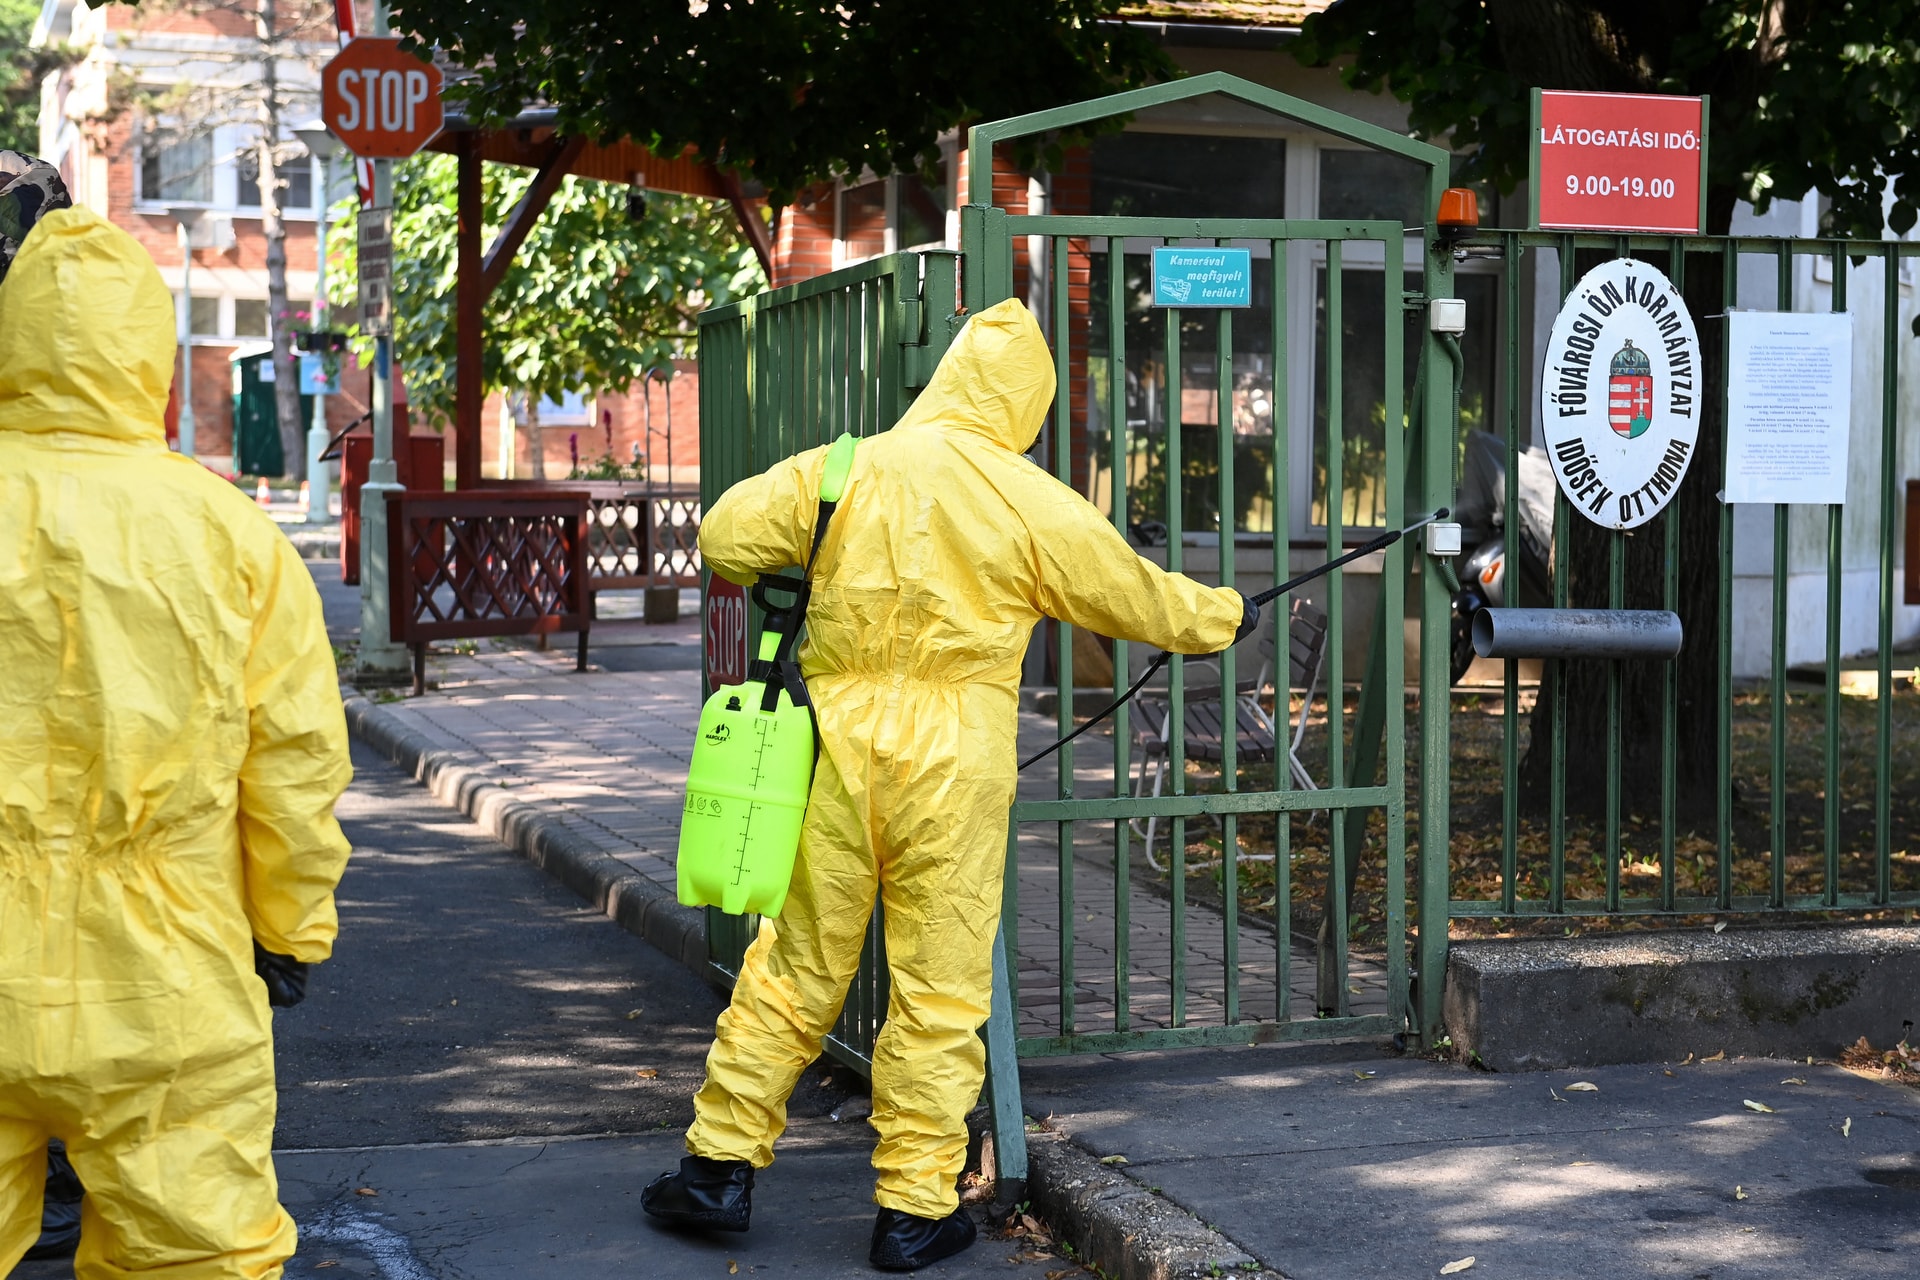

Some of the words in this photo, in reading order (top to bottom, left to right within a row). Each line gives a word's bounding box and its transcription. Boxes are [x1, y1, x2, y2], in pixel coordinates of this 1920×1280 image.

[337, 68, 429, 132] STOP
[1541, 125, 1659, 148] LÁTOGATÁSI
[1664, 130, 1701, 150] IDŐ:
[1566, 175, 1675, 198] 9.00-19.00
[1170, 255, 1225, 266] Kamerával
[1187, 269, 1242, 283] megfigyelt
[1202, 287, 1237, 298] terület
[1551, 313, 1603, 418] FŐVÁROSI
[1581, 275, 1692, 419] ÖNKORMÁNYZAT
[1555, 437, 1613, 515] IDŐSEK
[1619, 438, 1690, 523] OTTHONA
[708, 596, 743, 678] STOP
